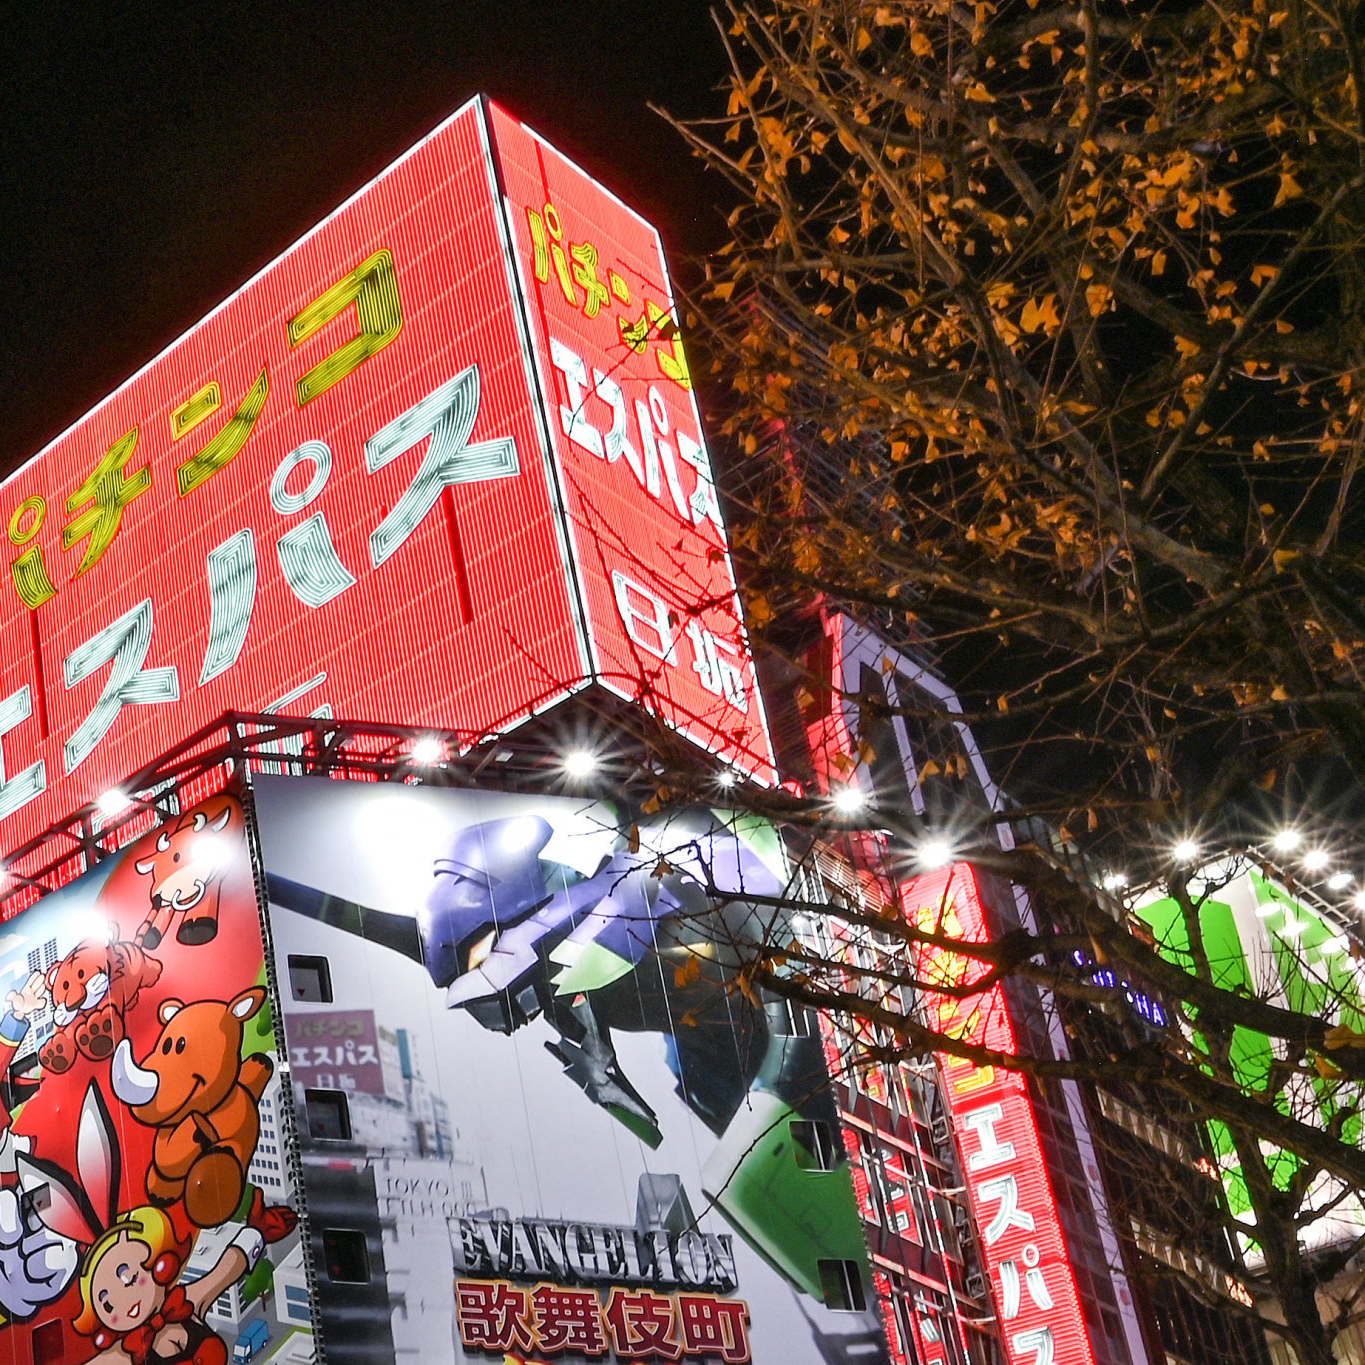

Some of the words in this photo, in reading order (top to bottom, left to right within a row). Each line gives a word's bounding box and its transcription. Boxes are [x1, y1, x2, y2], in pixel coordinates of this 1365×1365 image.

[525, 202, 693, 390] パチンコ
[549, 337, 728, 552] エスパス
[289, 1040, 381, 1068] エスパス
[295, 1019, 365, 1038] パチンコ
[451, 1214, 739, 1292] EVANGELION
[452, 1280, 751, 1362] 歌舞伎町
